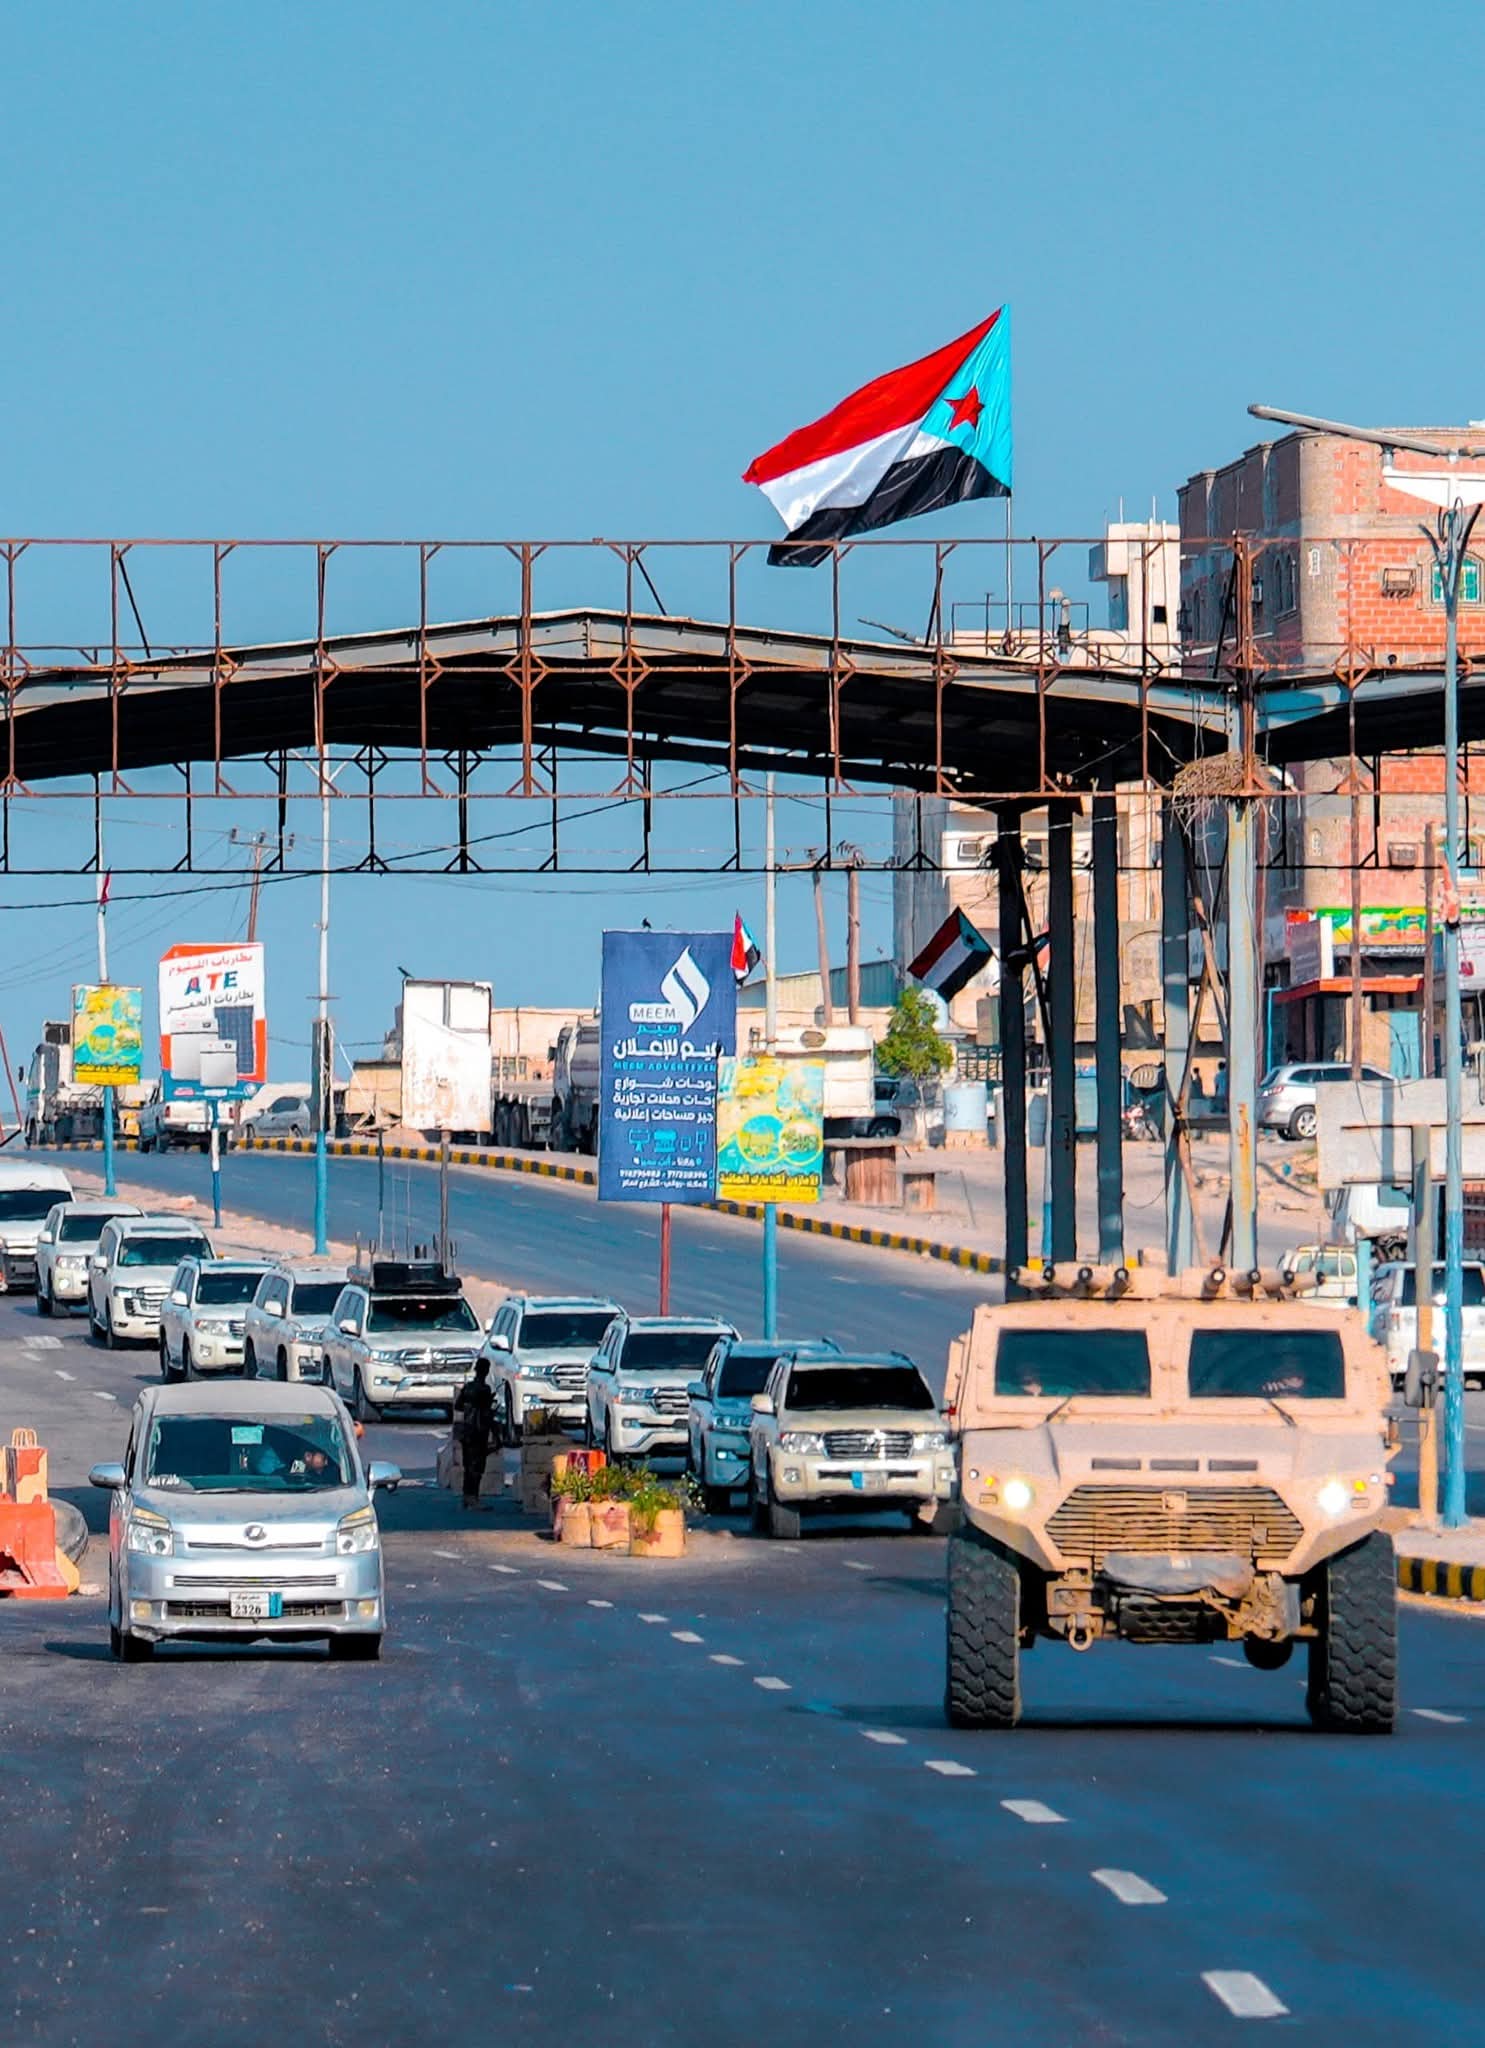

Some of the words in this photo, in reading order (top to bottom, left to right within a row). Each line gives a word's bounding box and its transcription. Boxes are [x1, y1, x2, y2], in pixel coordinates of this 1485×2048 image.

[211, 953, 253, 966] بطاريات
[184, 970, 239, 996] ATE
[214, 989, 254, 1004] بطاريات
[633, 1007, 676, 1019] MEEM
[613, 1037, 679, 1060] للإعلان
[614, 1076, 674, 1091] شوارع
[675, 1076, 716, 1091] وحات
[612, 1092, 646, 1106] تجارية
[647, 1092, 681, 1105] محلات
[651, 1108, 695, 1121] مساحات
